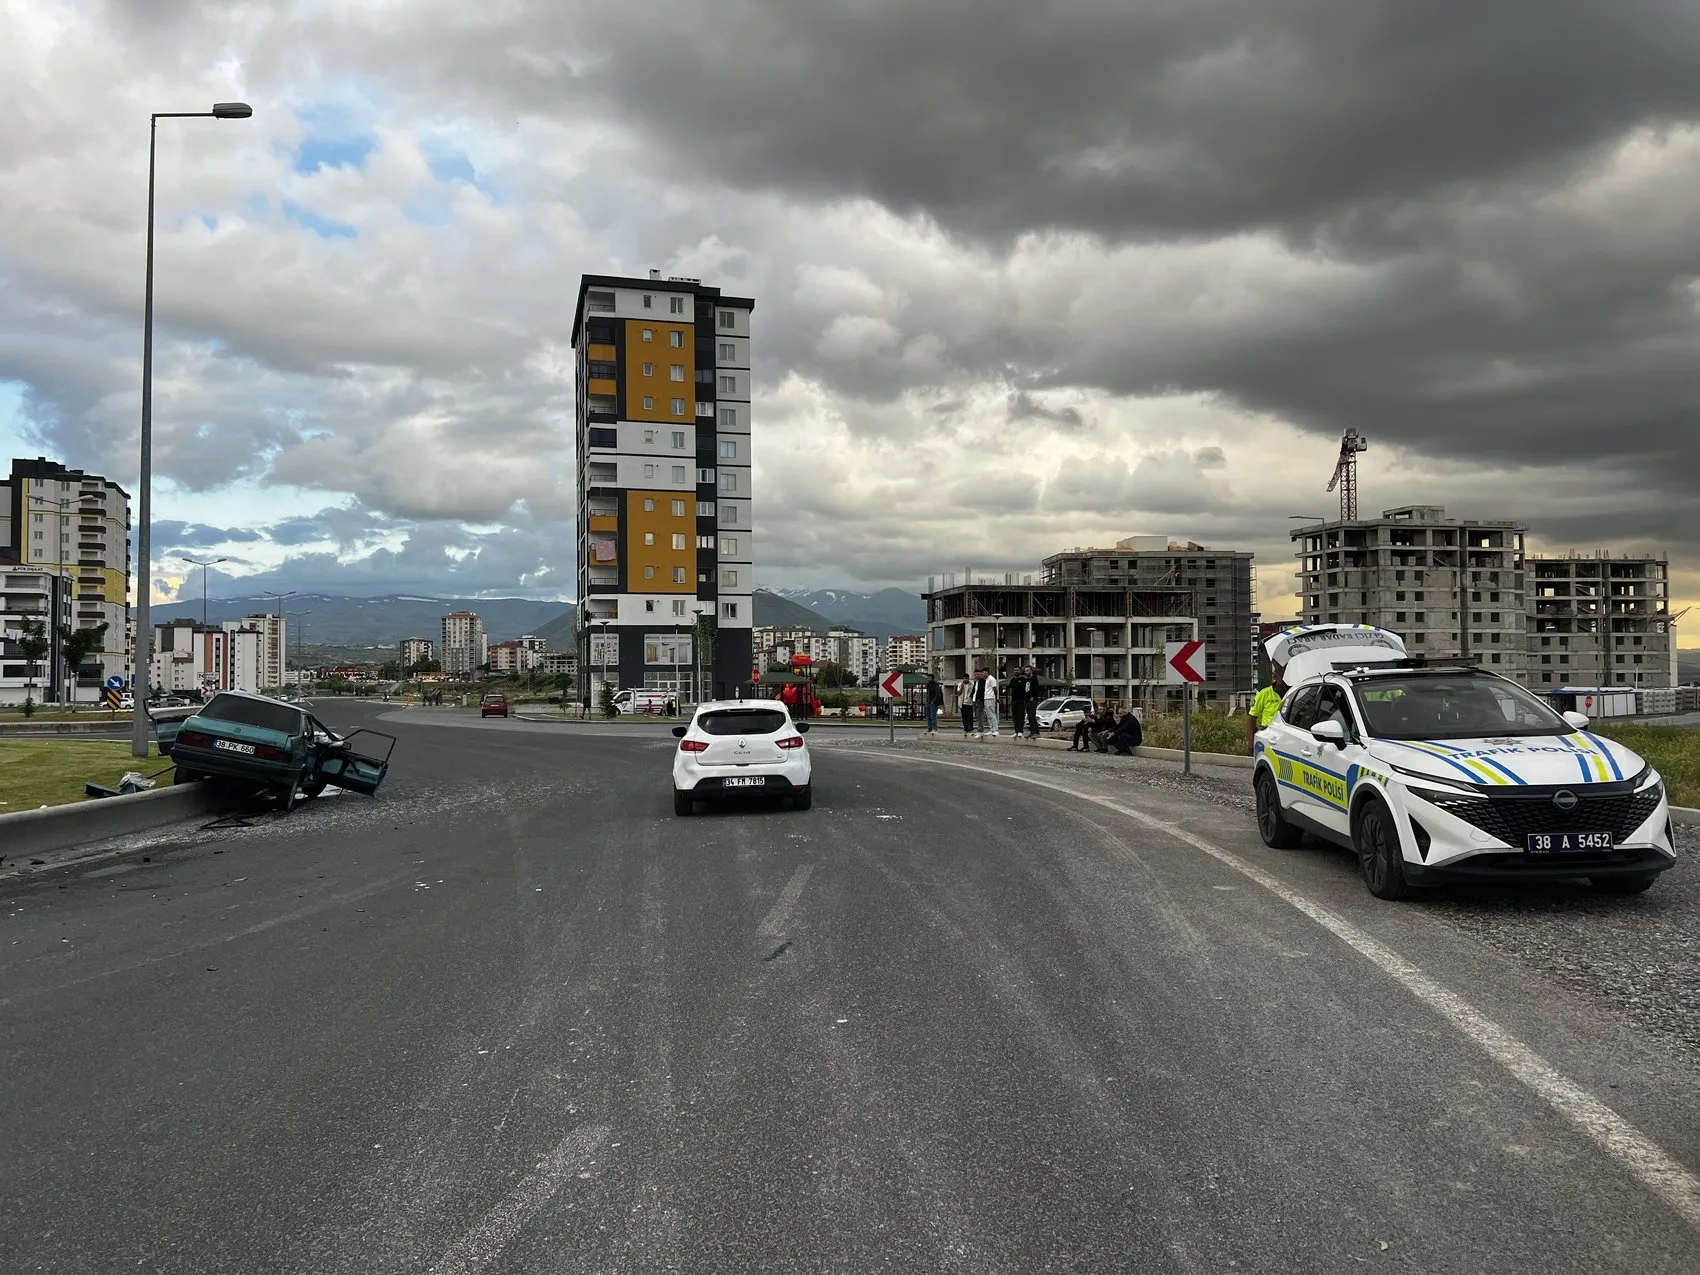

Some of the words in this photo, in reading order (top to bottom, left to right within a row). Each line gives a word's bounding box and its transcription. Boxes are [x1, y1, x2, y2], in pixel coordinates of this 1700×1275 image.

[1320, 632, 1352, 641] RADAR
[216, 740, 226, 748] 38
[228, 742, 239, 750] PK
[1447, 747, 1525, 760] TRAFİK
[1527, 746, 1599, 755] POLİSİ
[726, 778, 735, 786] 34
[749, 777, 764, 785] 7815
[1303, 770, 1323, 792] TRAFİK
[1323, 779, 1344, 802] POLİSİ
[1535, 835, 1551, 849] 38
[1562, 834, 1570, 849] A
[1578, 833, 1610, 848] 5452
